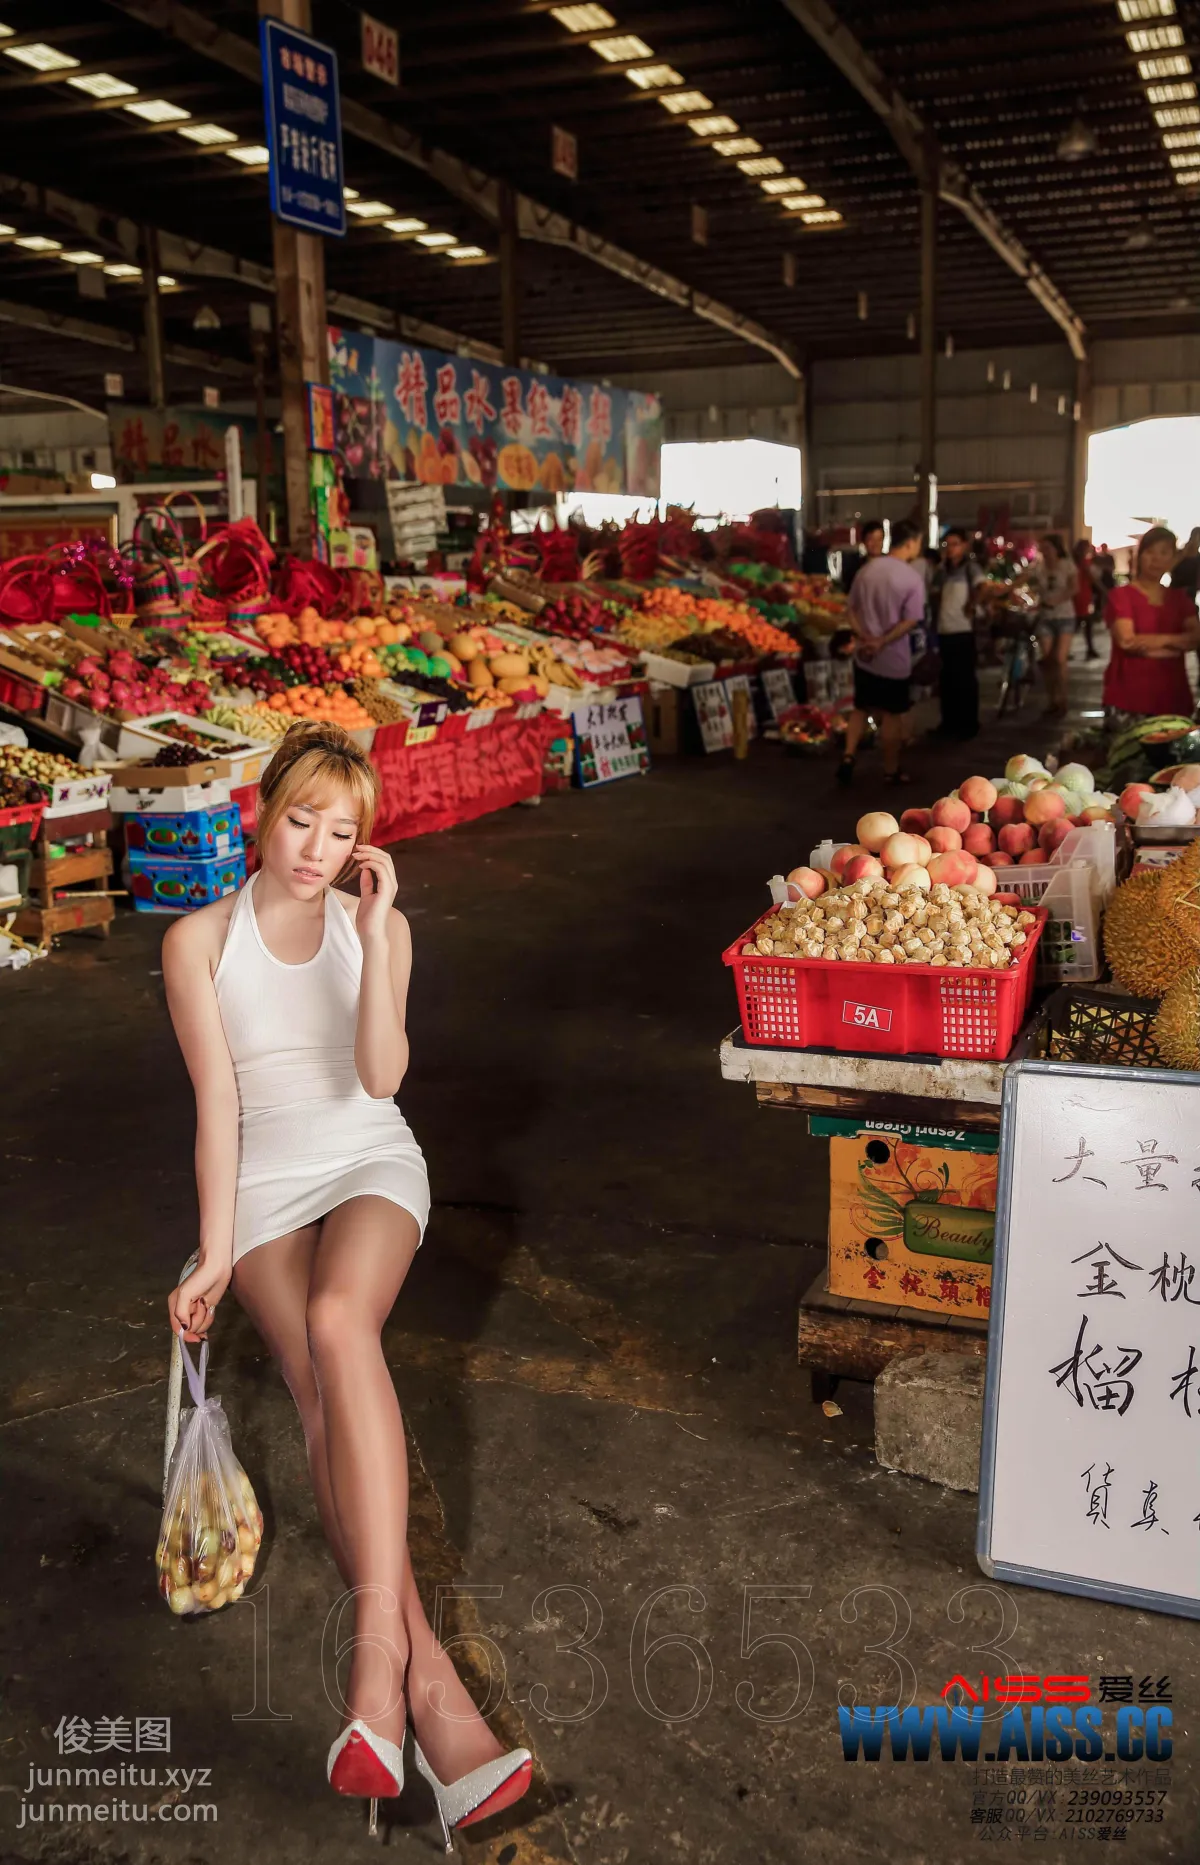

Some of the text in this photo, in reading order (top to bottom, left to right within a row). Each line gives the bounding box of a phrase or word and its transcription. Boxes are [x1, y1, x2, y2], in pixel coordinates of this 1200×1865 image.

[854, 1006, 879, 1028] 5A
[1052, 1136, 1200, 1192] 大量
[912, 1215, 994, 1257] Beauty
